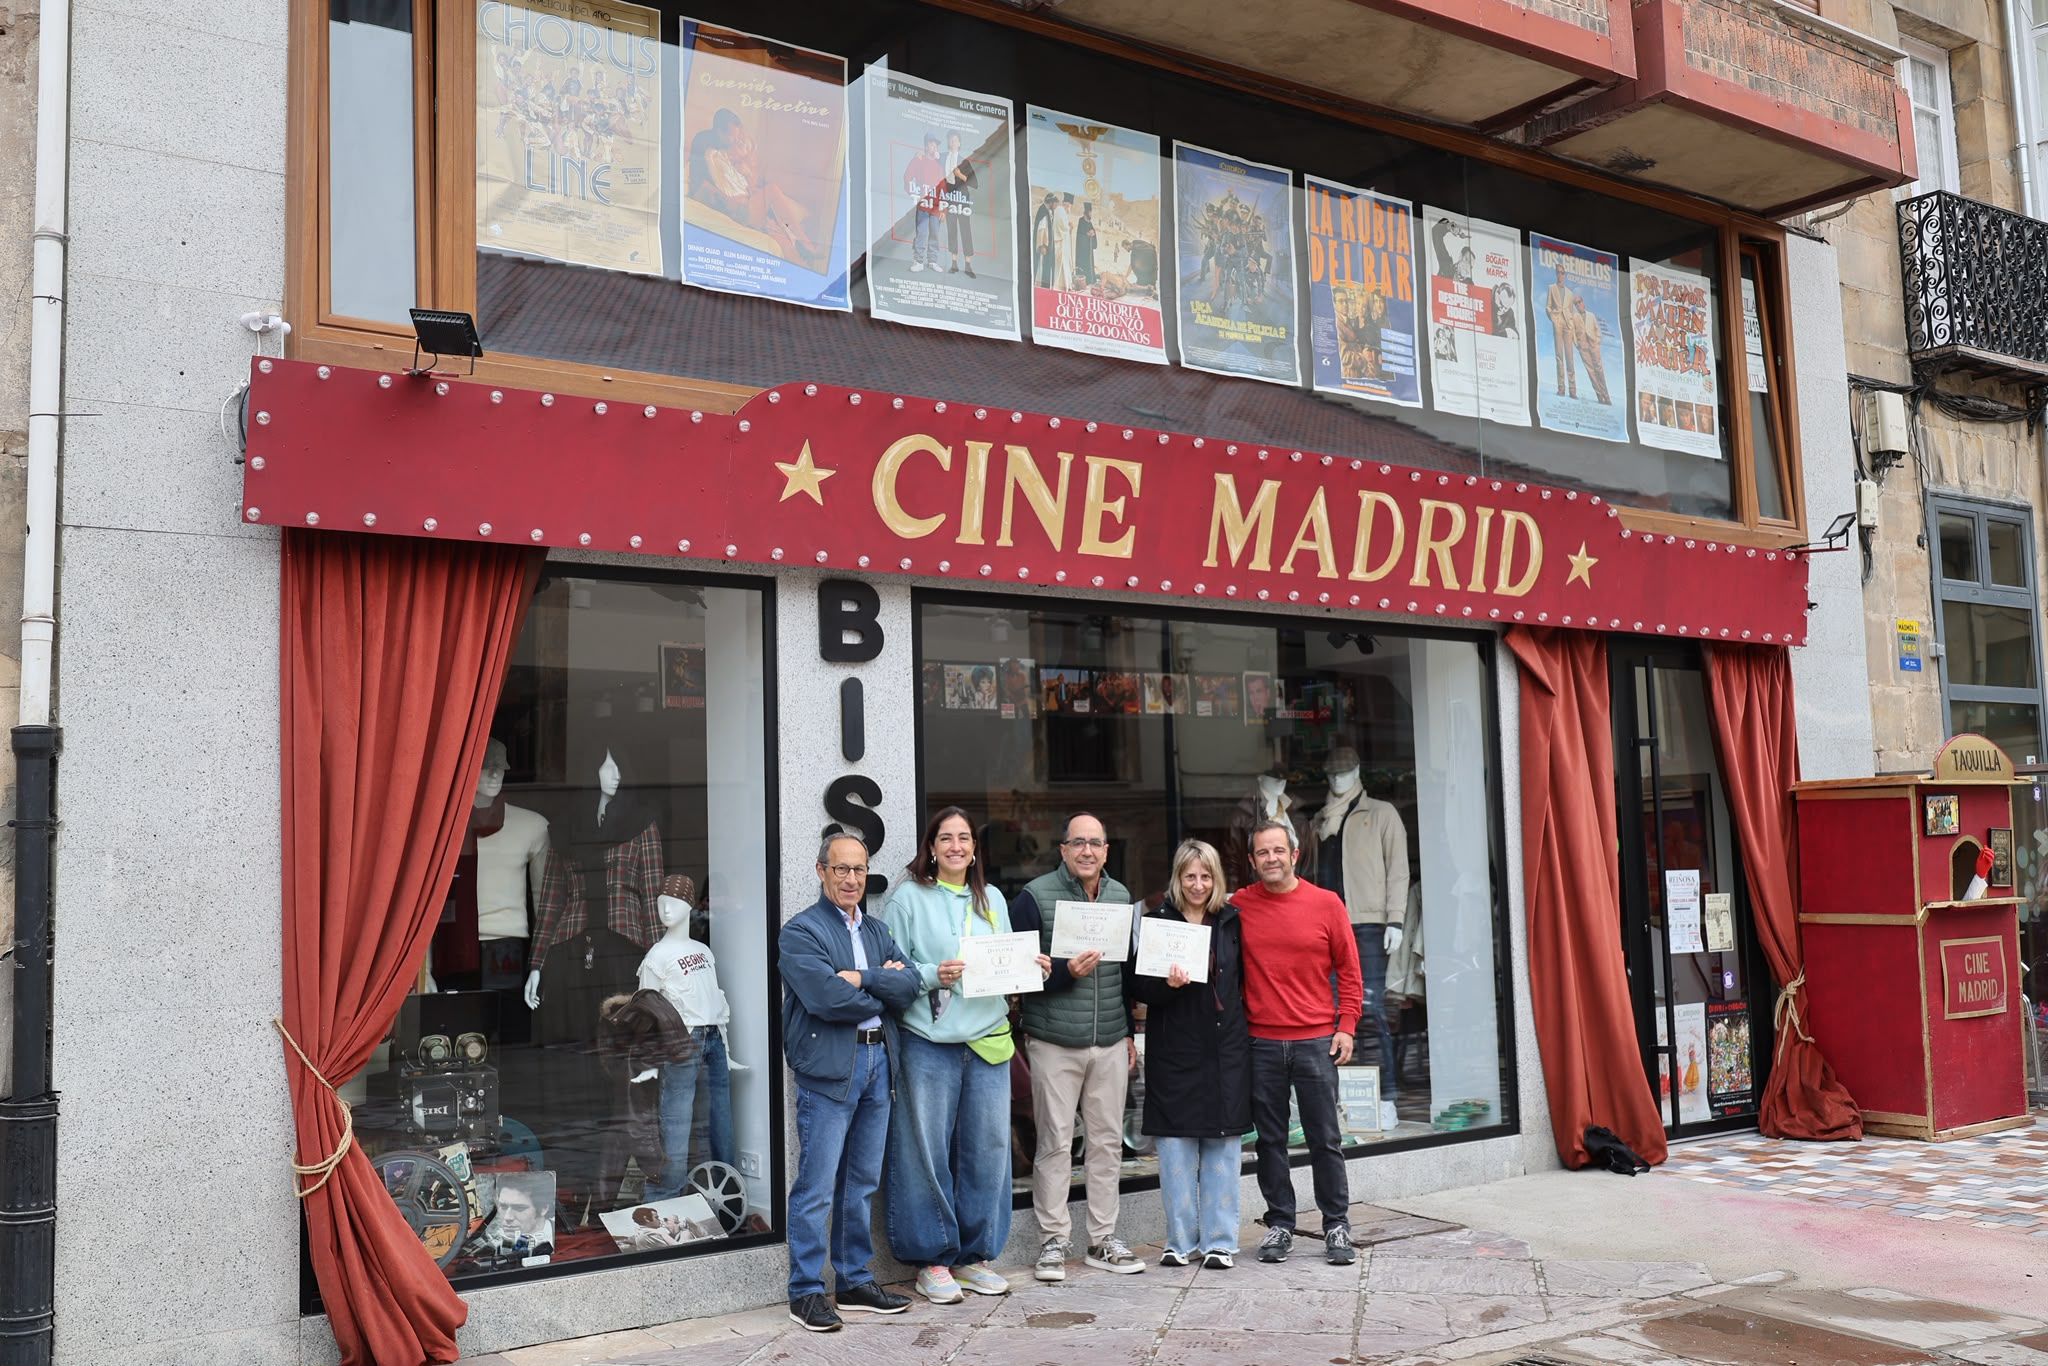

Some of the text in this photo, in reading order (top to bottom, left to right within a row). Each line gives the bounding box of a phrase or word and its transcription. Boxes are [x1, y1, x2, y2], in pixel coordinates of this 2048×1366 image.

[479, 1, 657, 78] CHORUS
[700, 72, 776, 94] Querido
[872, 77, 919, 98] Dudley Moore
[739, 93, 830, 116] Detective
[959, 100, 1007, 117] Kirk Cameron
[524, 144, 611, 207] LINE
[909, 181, 921, 194] De
[922, 185, 937, 198] Tal
[938, 200, 973, 217] Palo
[1310, 185, 1410, 256] LA RUBIA
[1310, 235, 1413, 302] DEL BAR
[1485, 254, 1510, 267] BOGART
[1486, 267, 1508, 279] MARCH
[1056, 304, 1083, 320] QUE
[1058, 292, 1141, 320] UNA HISTORIA
[1635, 298, 1706, 335] MATEN
[1049, 316, 1084, 333] HACE
[872, 433, 1544, 597] CINE MADRID
[1951, 749, 2001, 772] TAQUILLA
[1964, 952, 1990, 975] CINE
[1958, 978, 1998, 1003] MADRID
